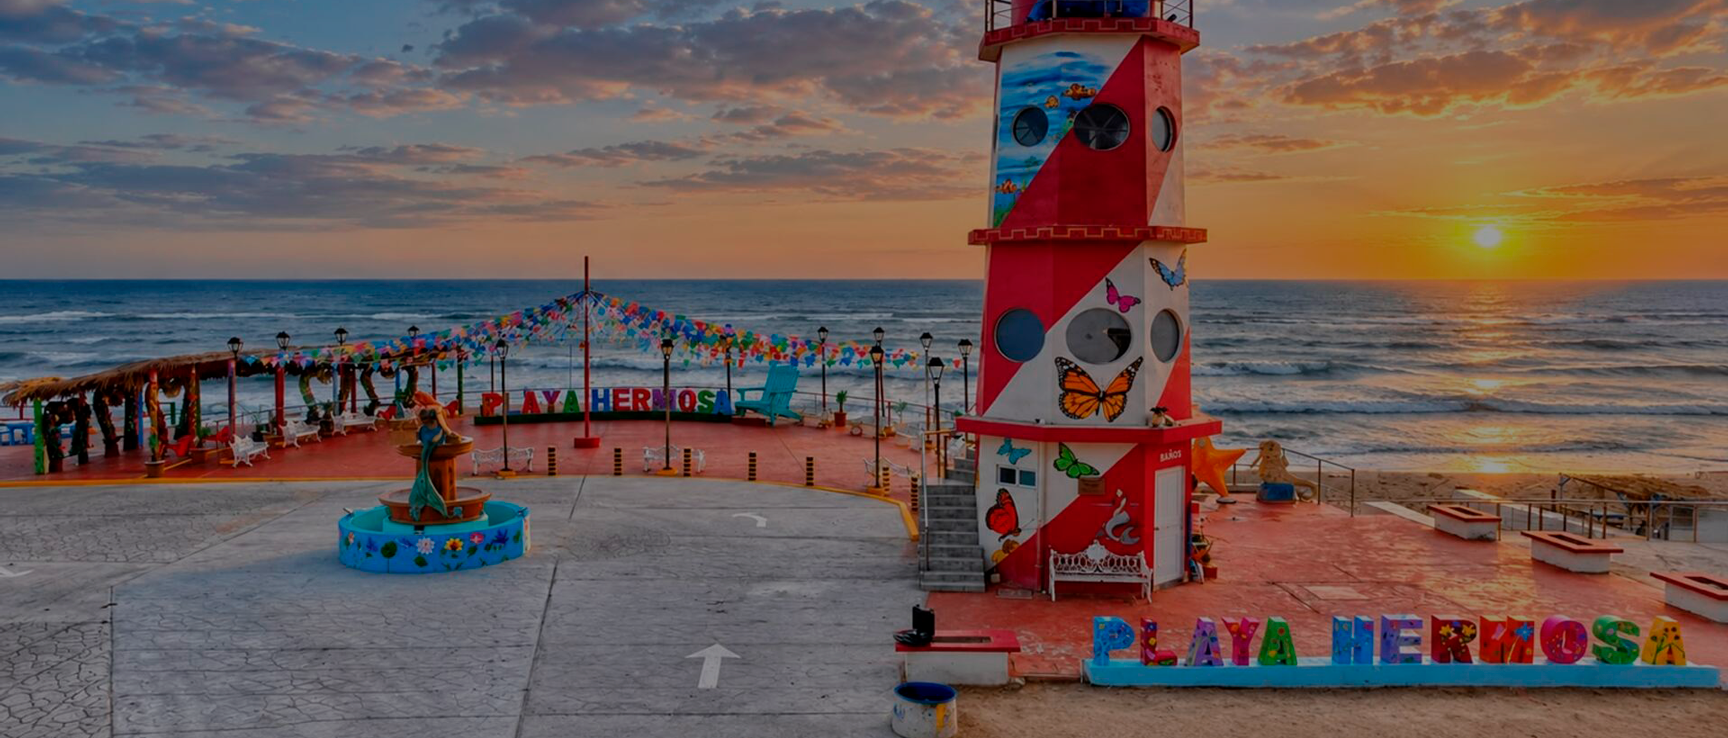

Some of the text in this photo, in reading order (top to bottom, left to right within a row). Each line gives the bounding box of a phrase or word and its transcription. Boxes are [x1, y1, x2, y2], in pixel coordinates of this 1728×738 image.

[591, 387, 732, 416] HERMOSA
[1160, 449, 1182, 462] BAÑOS
[1093, 614, 1686, 666] PLAYA HERMOSA
